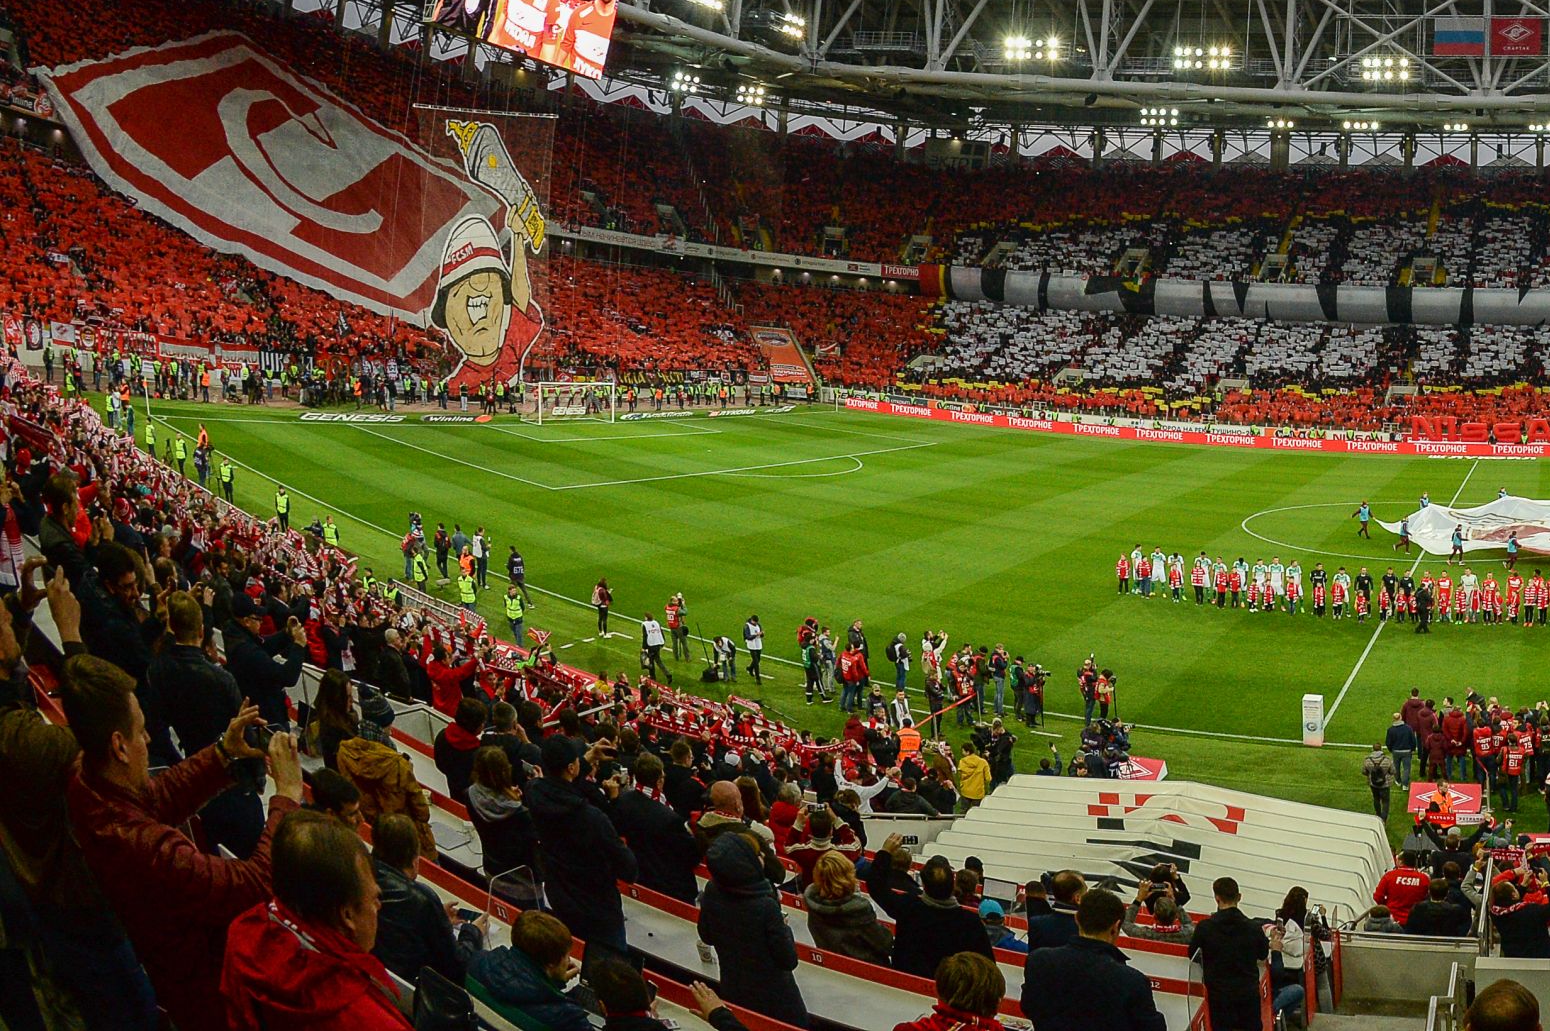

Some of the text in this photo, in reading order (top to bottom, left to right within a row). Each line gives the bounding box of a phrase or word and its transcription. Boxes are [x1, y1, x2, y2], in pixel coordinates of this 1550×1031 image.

[451, 244, 474, 264] FCSM
[884, 265, 919, 277] ТРЁХГОРНО
[300, 412, 407, 423] GENESIS
[429, 415, 474, 423] Winline
[1395, 876, 1420, 886] FCSM
[1150, 981, 1160, 989] 12
